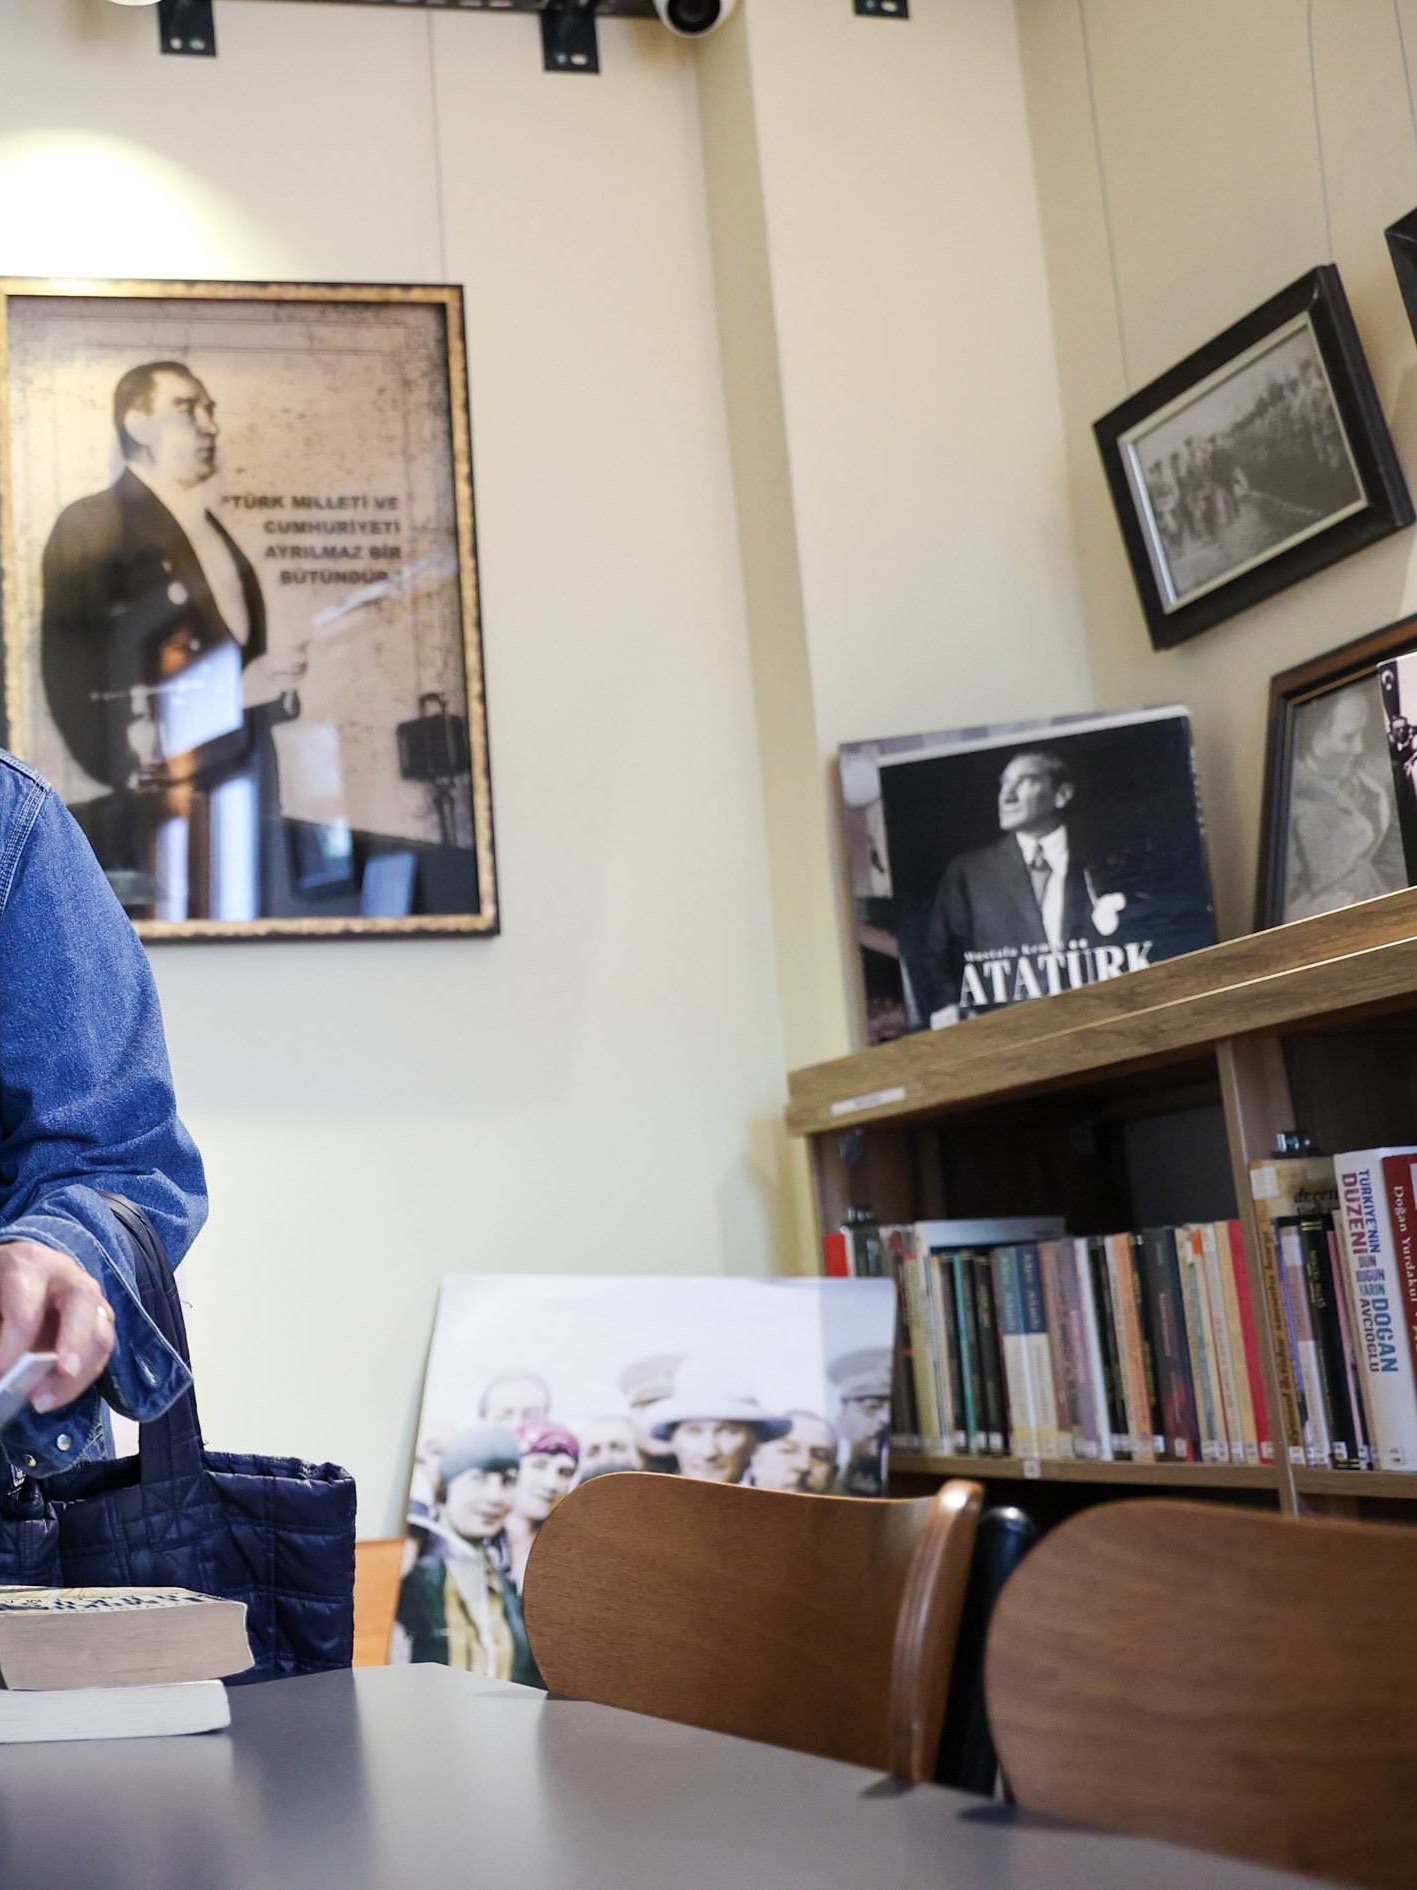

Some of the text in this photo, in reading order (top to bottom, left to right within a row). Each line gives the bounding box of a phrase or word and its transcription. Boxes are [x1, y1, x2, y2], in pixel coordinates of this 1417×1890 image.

[374, 495, 398, 510] VE
[264, 519, 400, 534] CUMHURİYETİ
[265, 543, 401, 560] AYRILMAZ BİR
[958, 937, 1153, 1008] ATATÜRK
[1394, 1186, 1408, 1232] Doğan
[1402, 1237, 1417, 1302] Yurdakul
